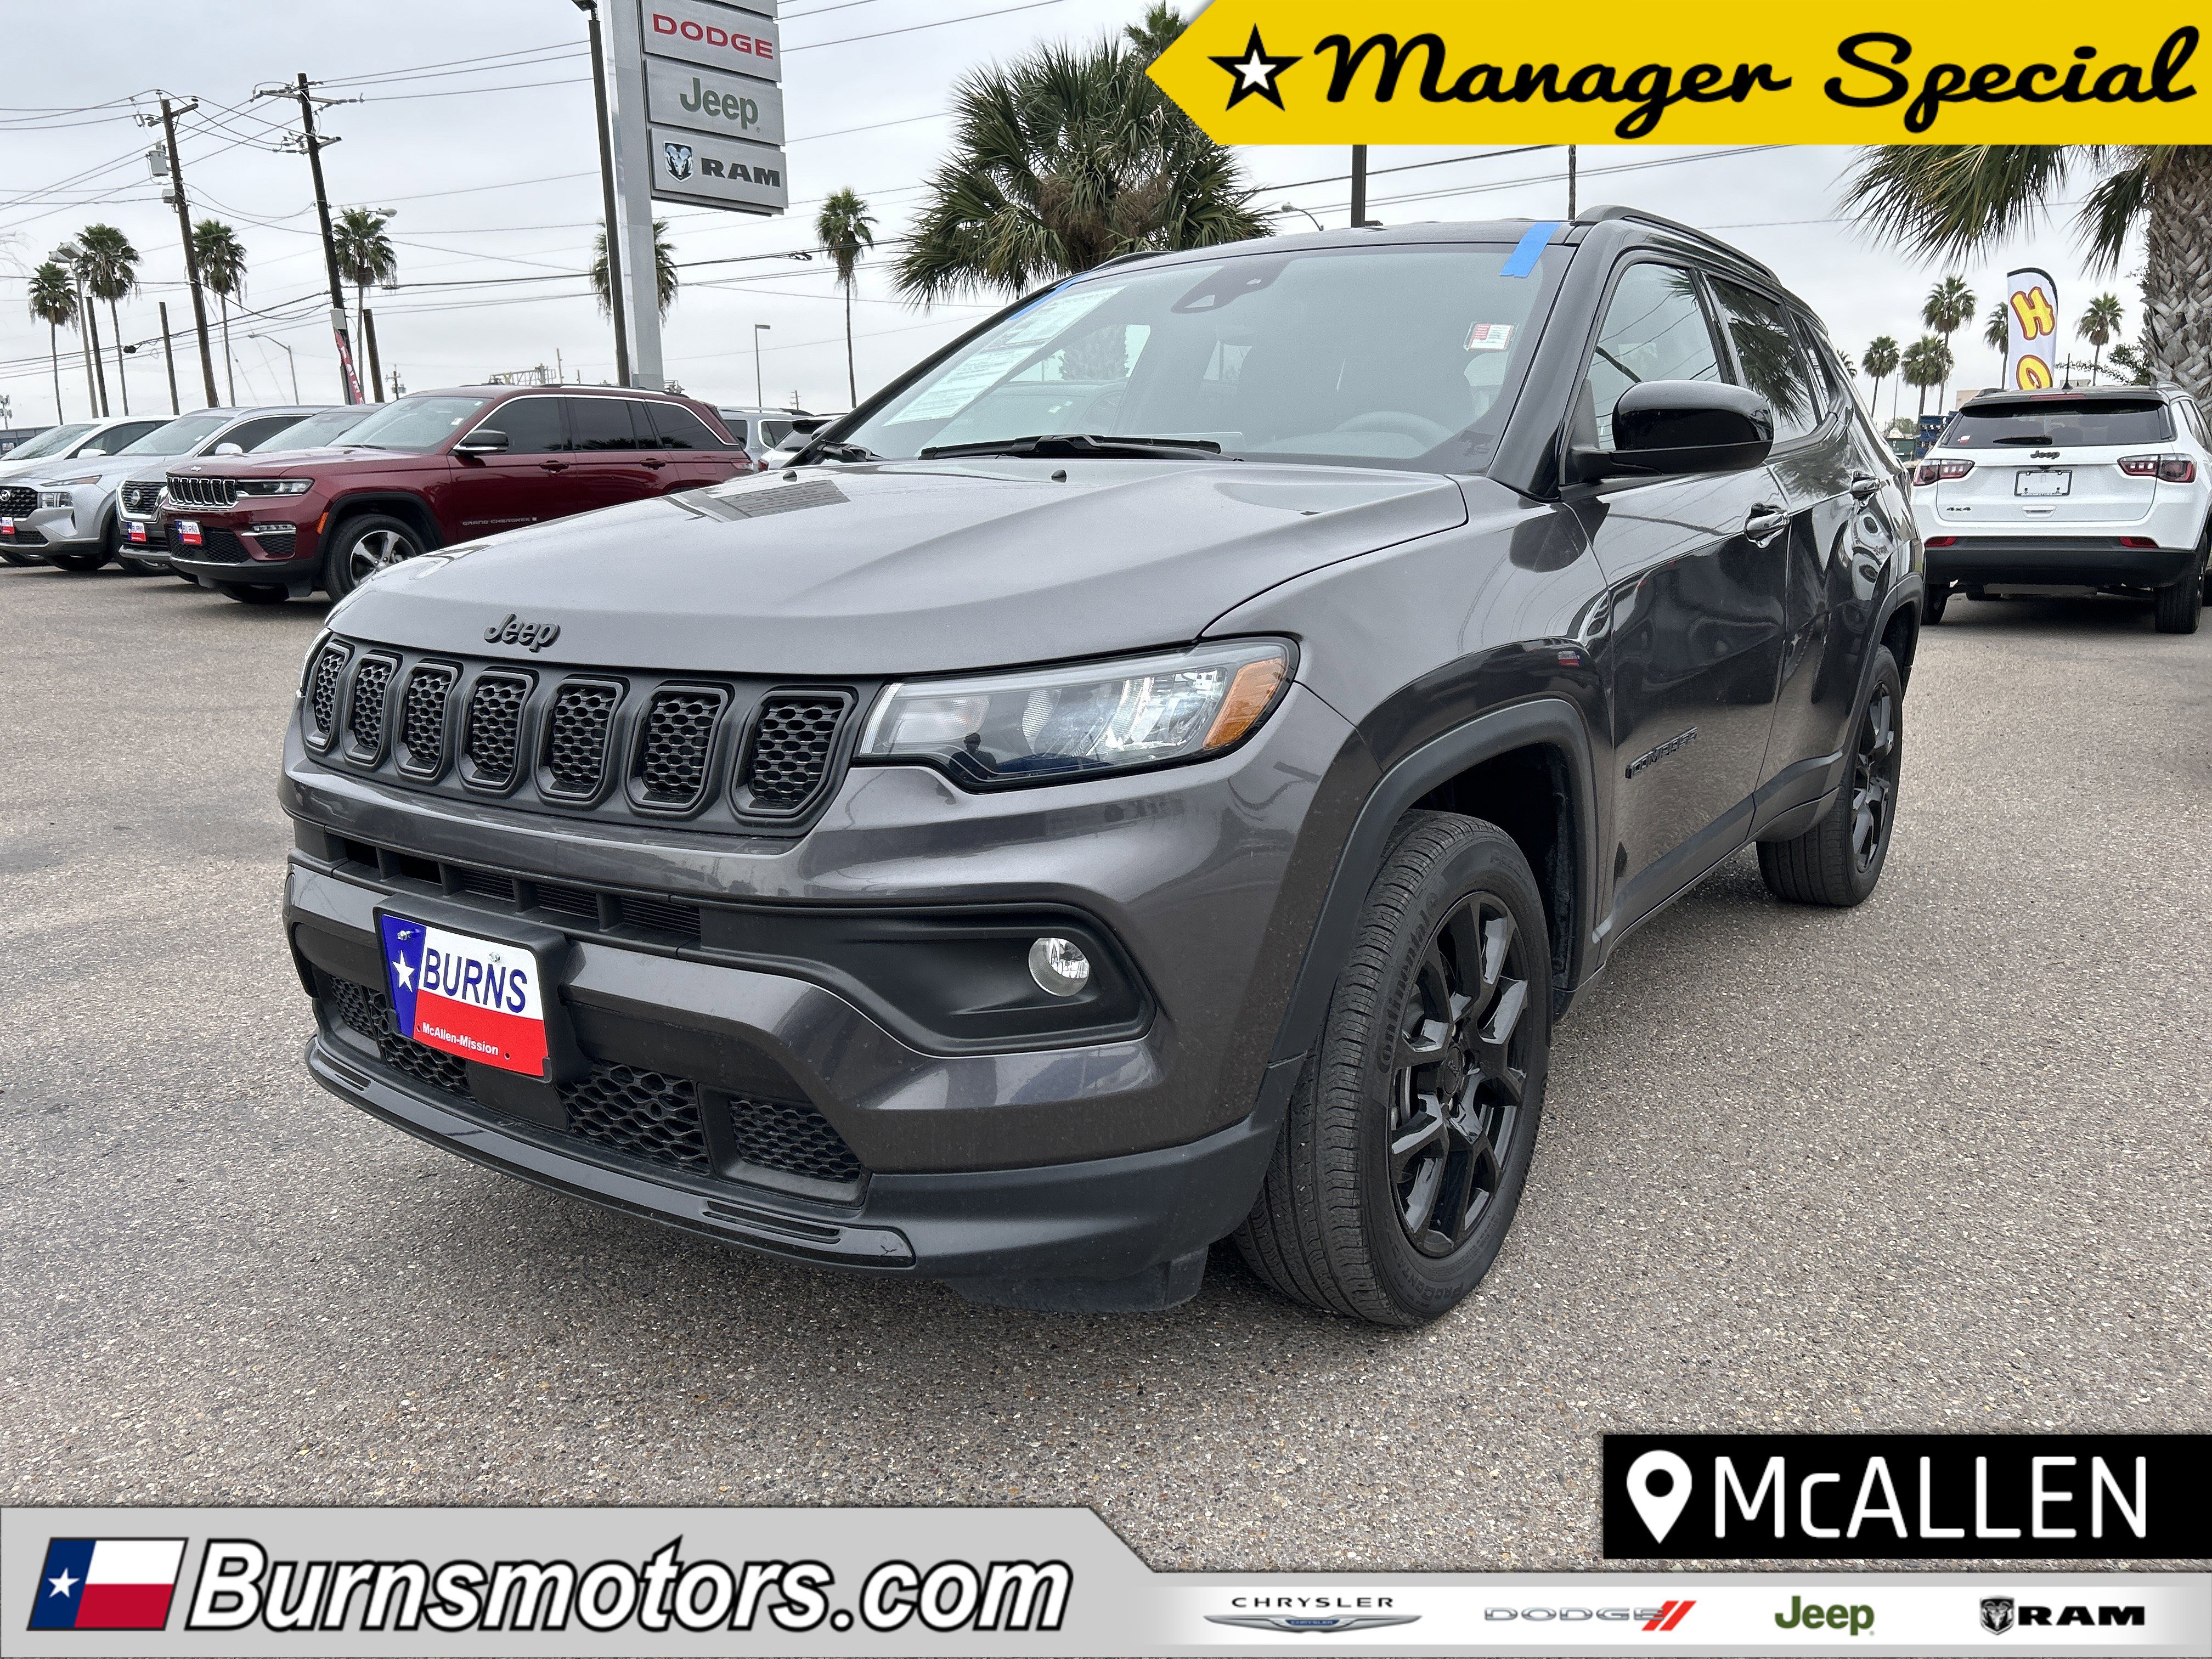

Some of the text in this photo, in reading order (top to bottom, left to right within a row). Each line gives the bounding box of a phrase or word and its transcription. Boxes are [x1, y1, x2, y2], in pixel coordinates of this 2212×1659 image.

[652, 13, 774, 60] DODGE
[680, 77, 759, 130] Jeep
[701, 157, 780, 188] RAM
[2030, 450, 2061, 460] Jeep
[183, 524, 198, 533] BURNS
[484, 613, 561, 653] Jeep
[424, 947, 528, 1013] BURNS
[422, 1022, 499, 1057] McAllen-Mission
